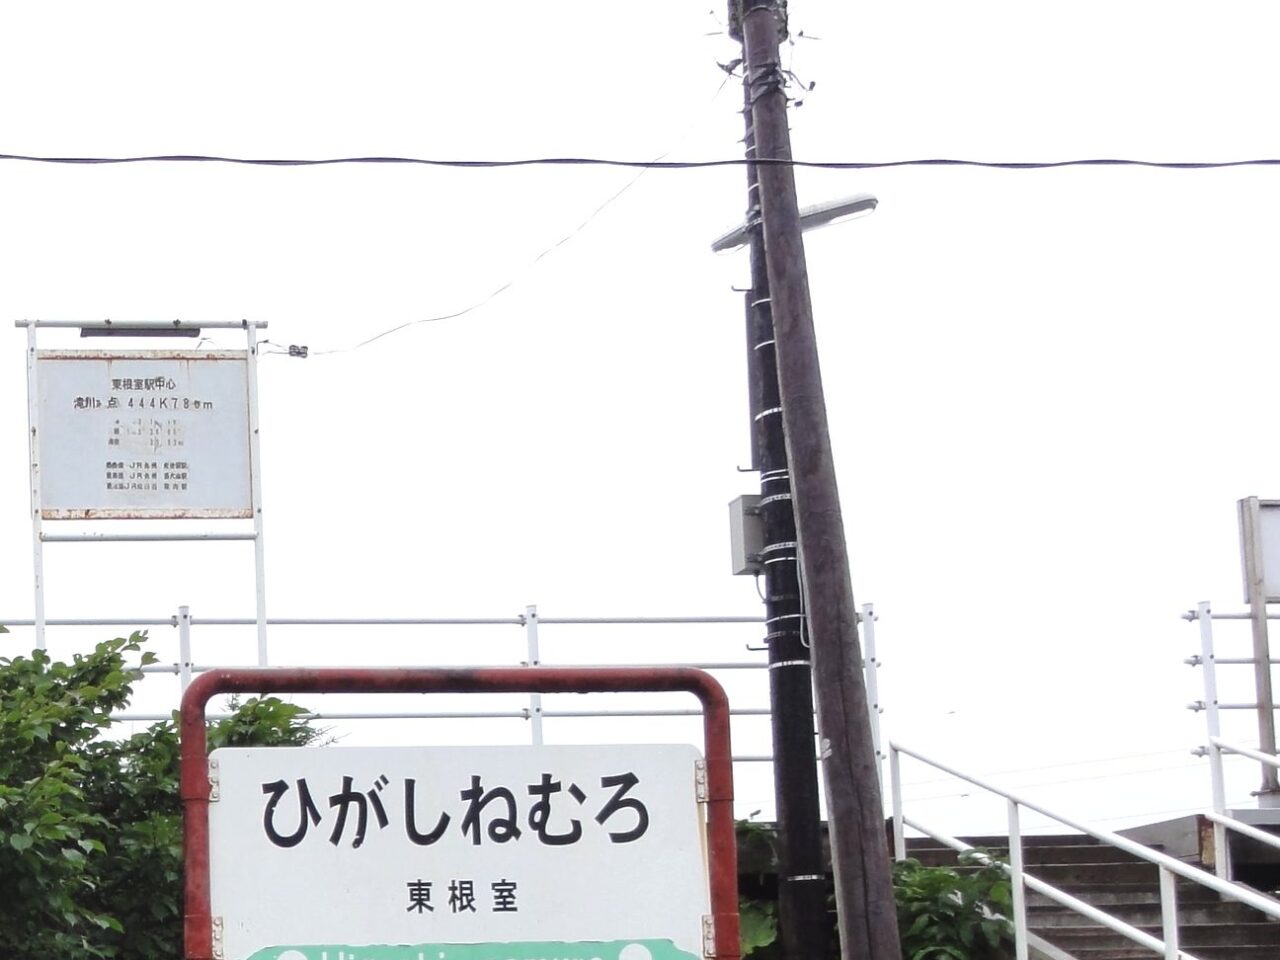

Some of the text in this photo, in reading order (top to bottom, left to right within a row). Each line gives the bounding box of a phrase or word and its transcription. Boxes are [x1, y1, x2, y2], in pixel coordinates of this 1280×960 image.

[261, 771, 651, 850] ひがしねむろ
[405, 878, 519, 914] 東根室
